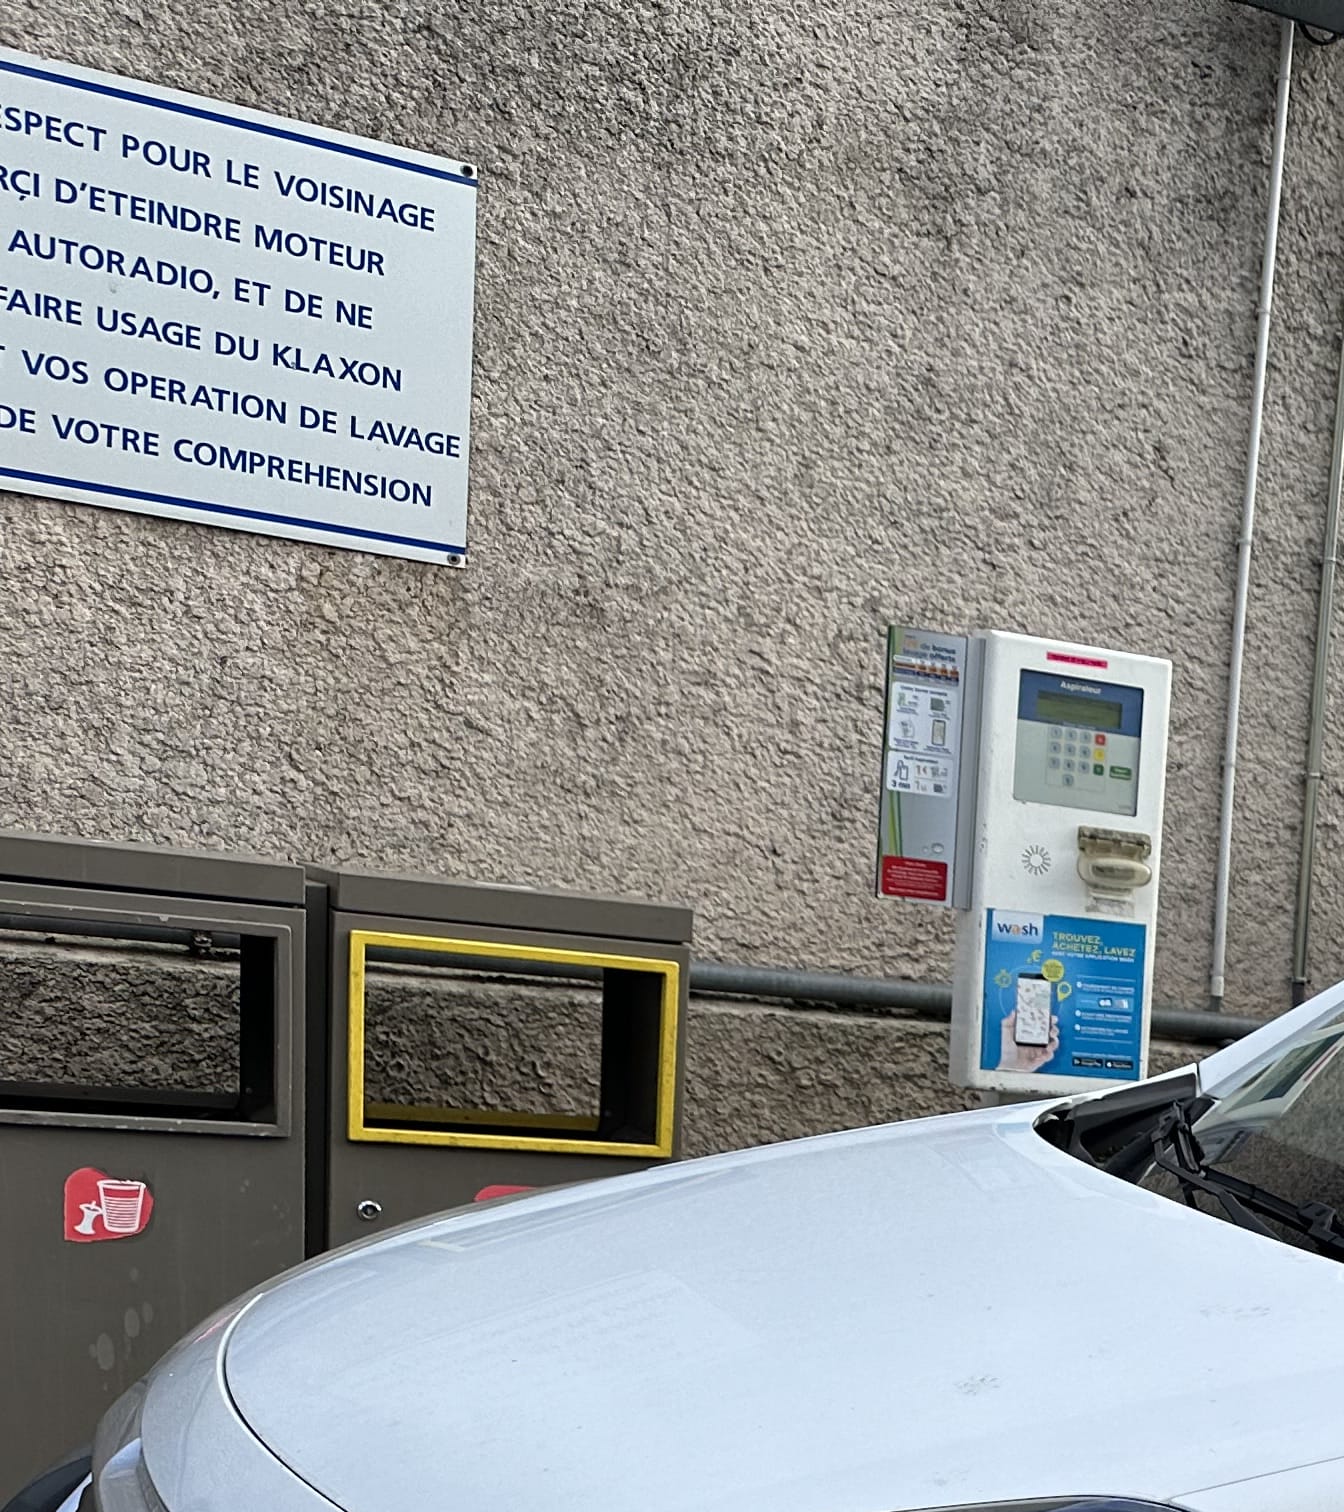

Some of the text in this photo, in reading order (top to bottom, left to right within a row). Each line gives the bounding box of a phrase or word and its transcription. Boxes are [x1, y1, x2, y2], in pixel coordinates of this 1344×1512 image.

[0, 107, 435, 231] SPECT POUR LE VOISINAGE
[55, 178, 241, 244] D'ETEINDRE
[254, 224, 385, 276] MOTEUR
[7, 229, 373, 330] AUTORADIO, ET DE NE
[97, 305, 201, 350] USAGE
[215, 331, 259, 361] DU
[272, 343, 402, 392] KLAXON
[22, 349, 460, 458] VOS OPERATION DE LAVAGE
[0, 404, 433, 507] DE VOTRE COMPREHENSION
[996, 921, 1039, 937] wash
